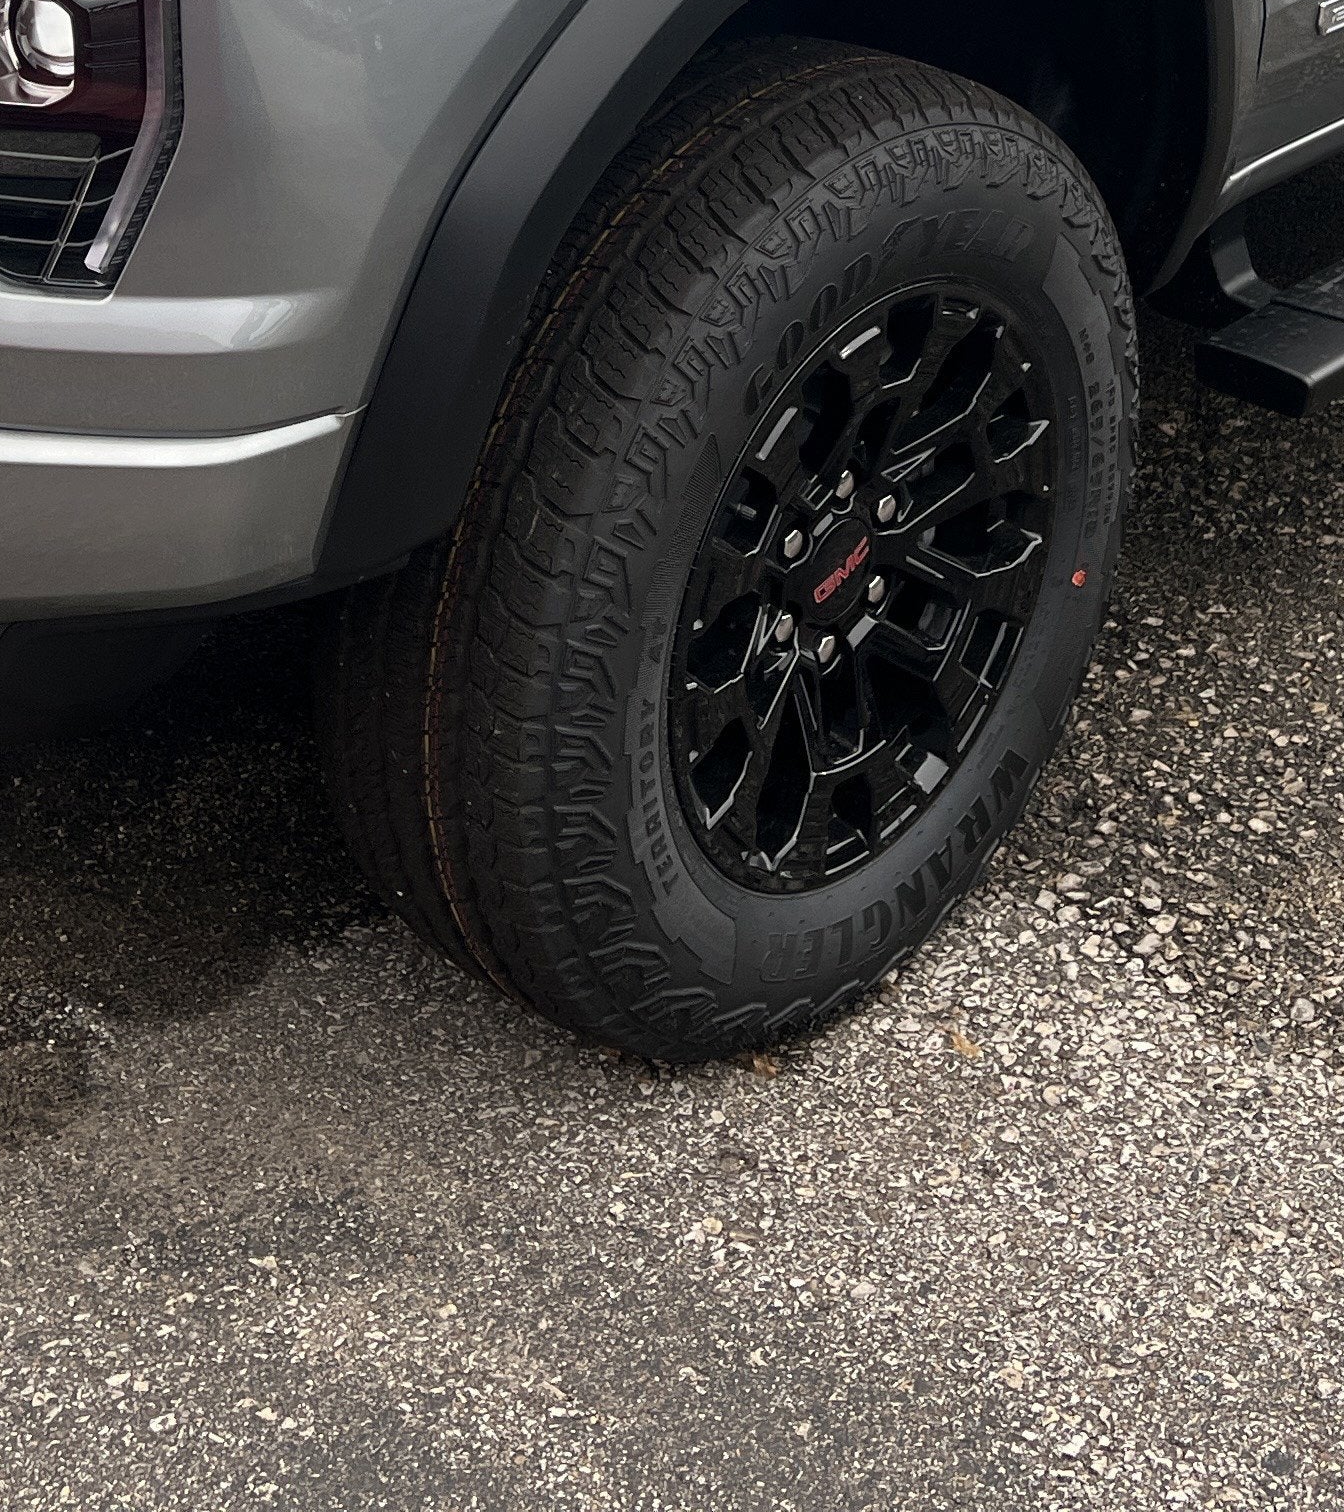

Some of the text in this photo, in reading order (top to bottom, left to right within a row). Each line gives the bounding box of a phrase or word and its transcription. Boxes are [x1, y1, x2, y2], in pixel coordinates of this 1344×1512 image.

[742, 208, 1034, 416] GOODYEAR
[813, 535, 870, 604] GMC
[637, 699, 680, 896] TERRITORY
[759, 746, 1031, 983] WRANGLER
